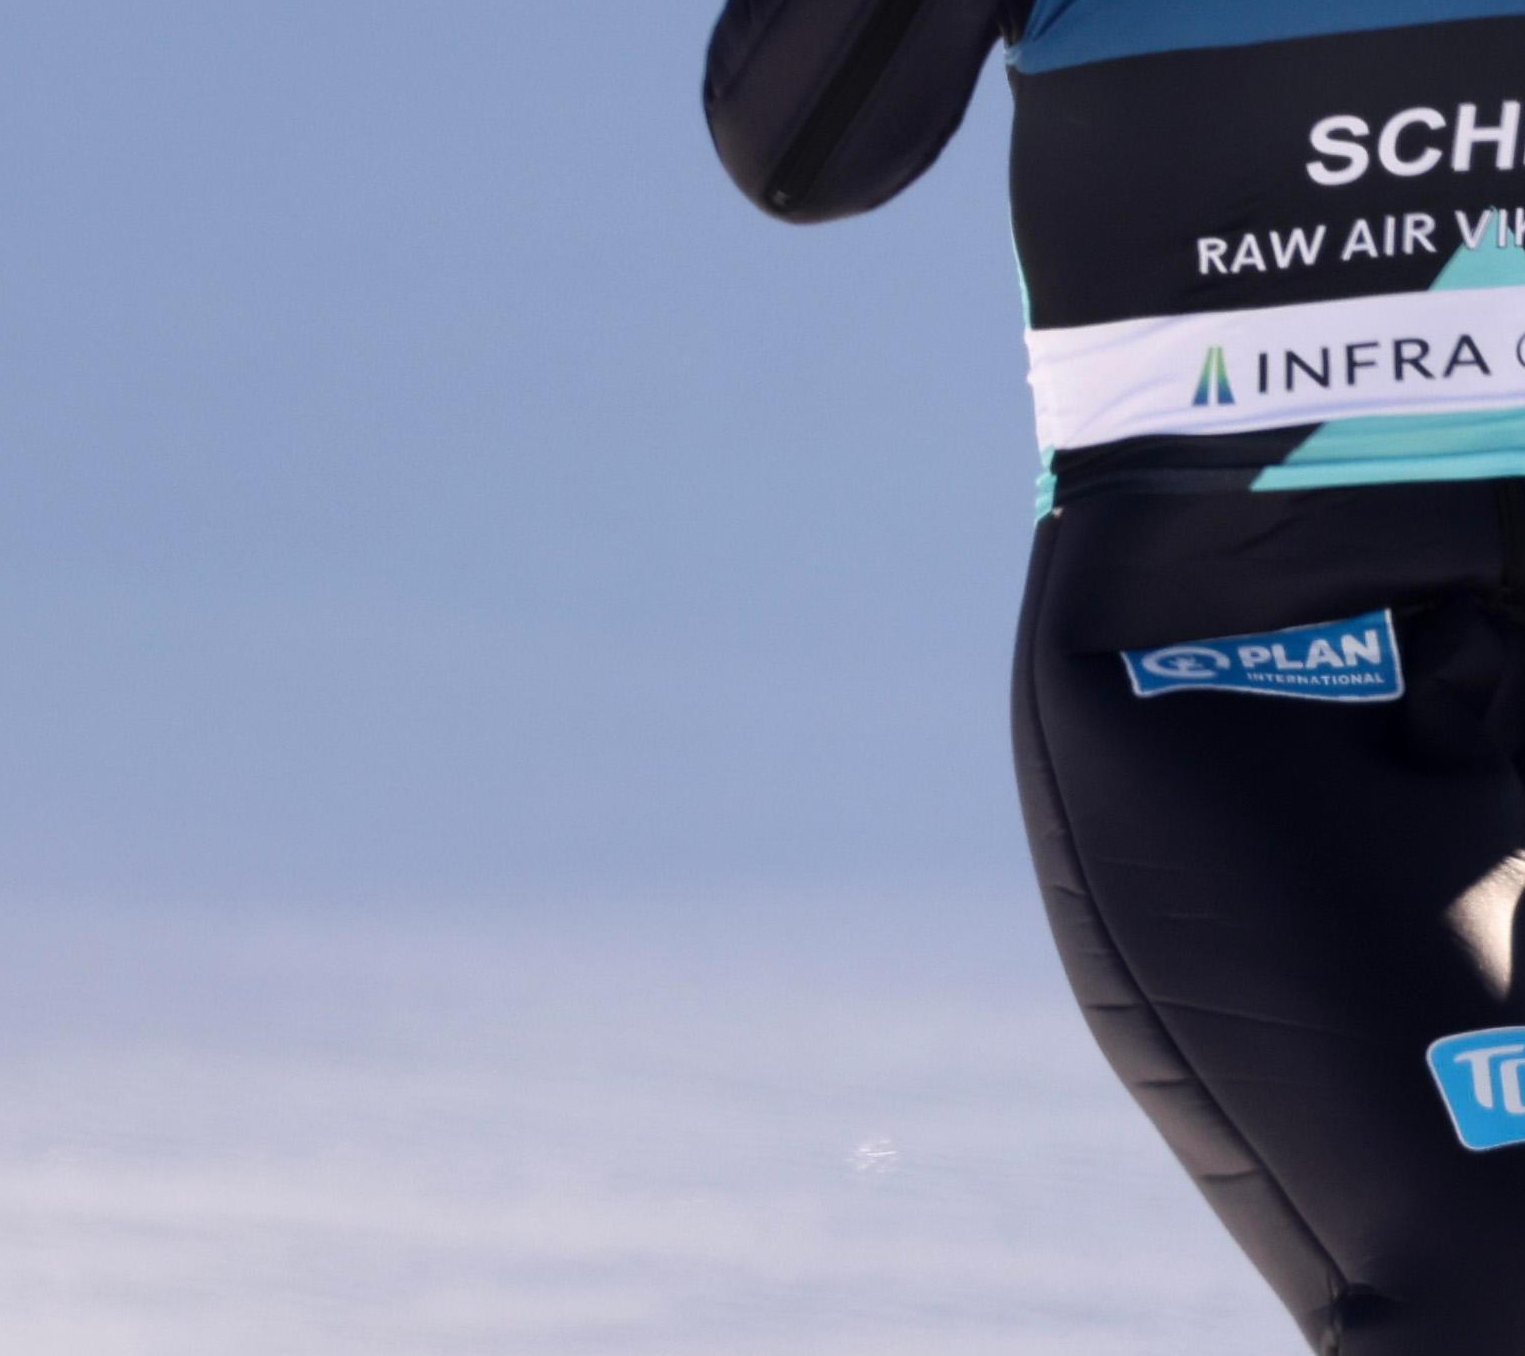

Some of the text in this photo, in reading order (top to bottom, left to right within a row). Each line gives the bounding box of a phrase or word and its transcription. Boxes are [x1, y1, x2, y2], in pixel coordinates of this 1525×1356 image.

[1197, 226, 1326, 274] RAW
[1342, 212, 1436, 261] AIR
[1258, 334, 1492, 394] INFRA
[1237, 629, 1382, 670] PLAN
[1247, 671, 1385, 686] INTERNATIONAL
